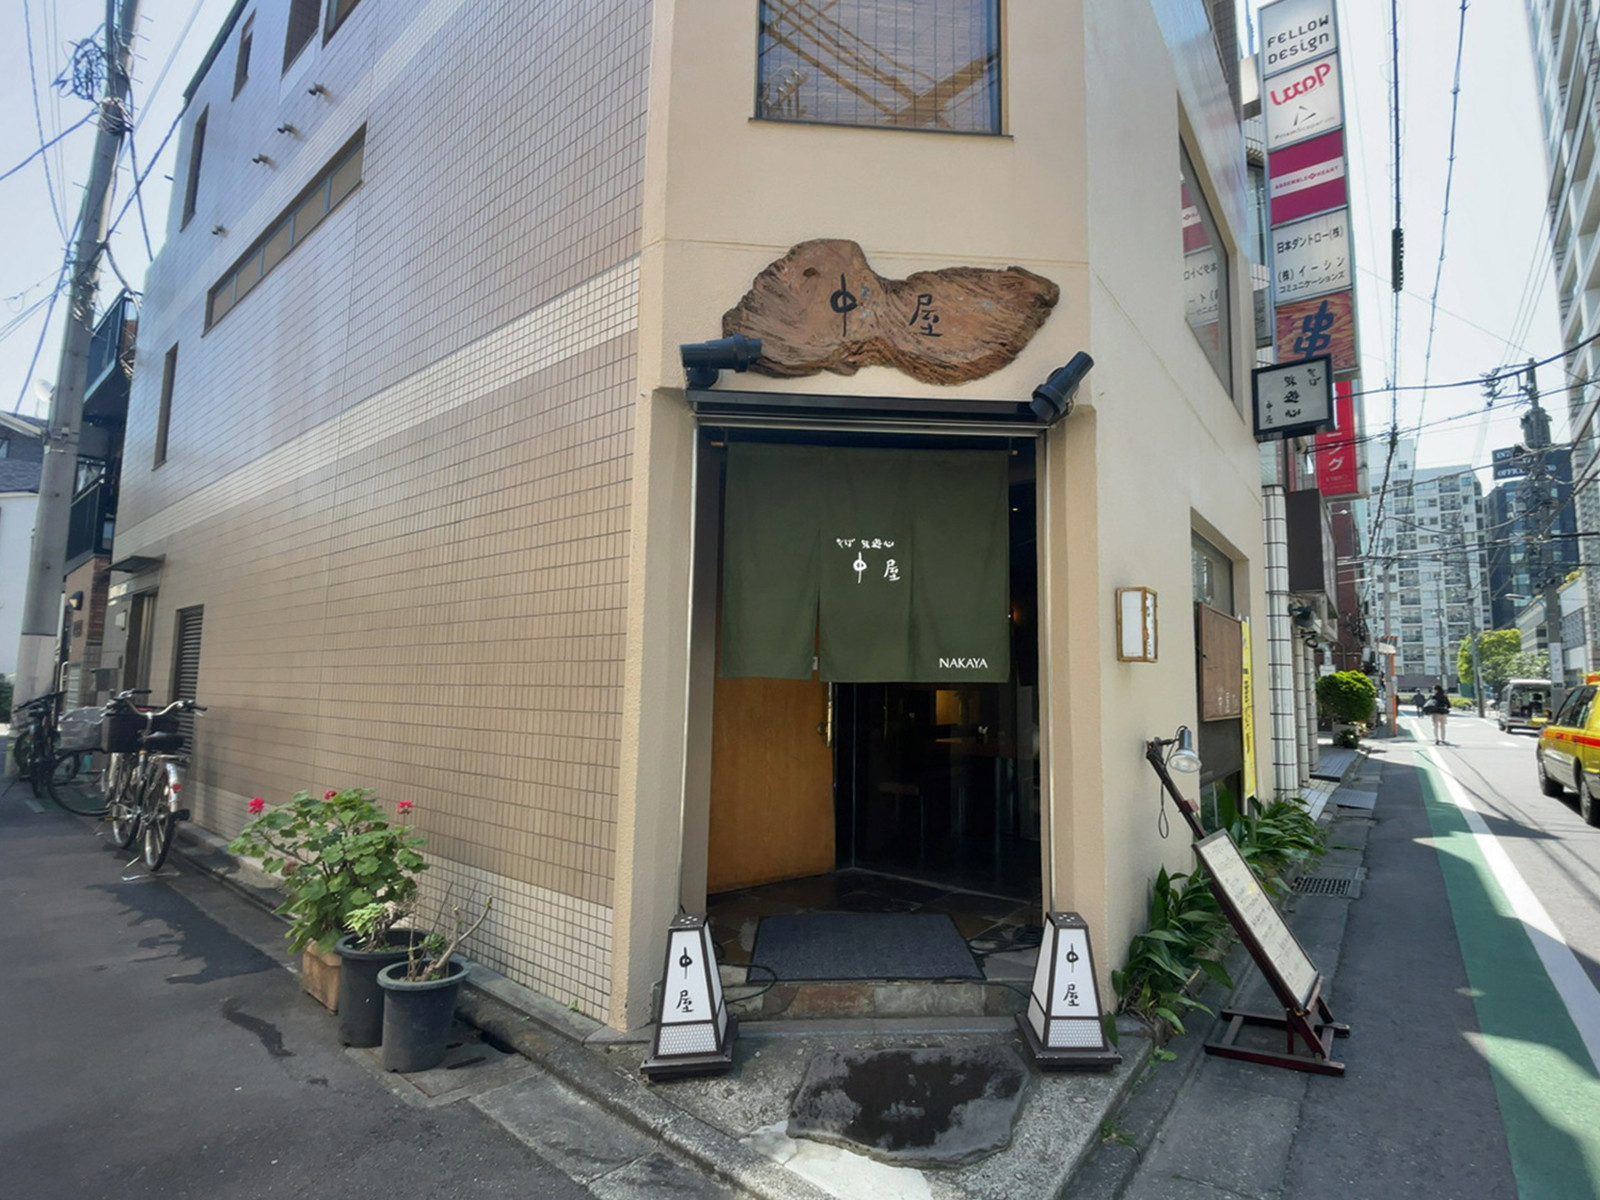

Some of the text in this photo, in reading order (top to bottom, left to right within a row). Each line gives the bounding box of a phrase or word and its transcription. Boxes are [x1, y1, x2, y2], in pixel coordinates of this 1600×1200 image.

[1267, 15, 1329, 48] FELLOW
[938, 657, 988, 669] NAKAYA
[676, 946, 694, 1013] 中屋
[1063, 943, 1080, 1007] 中屋
